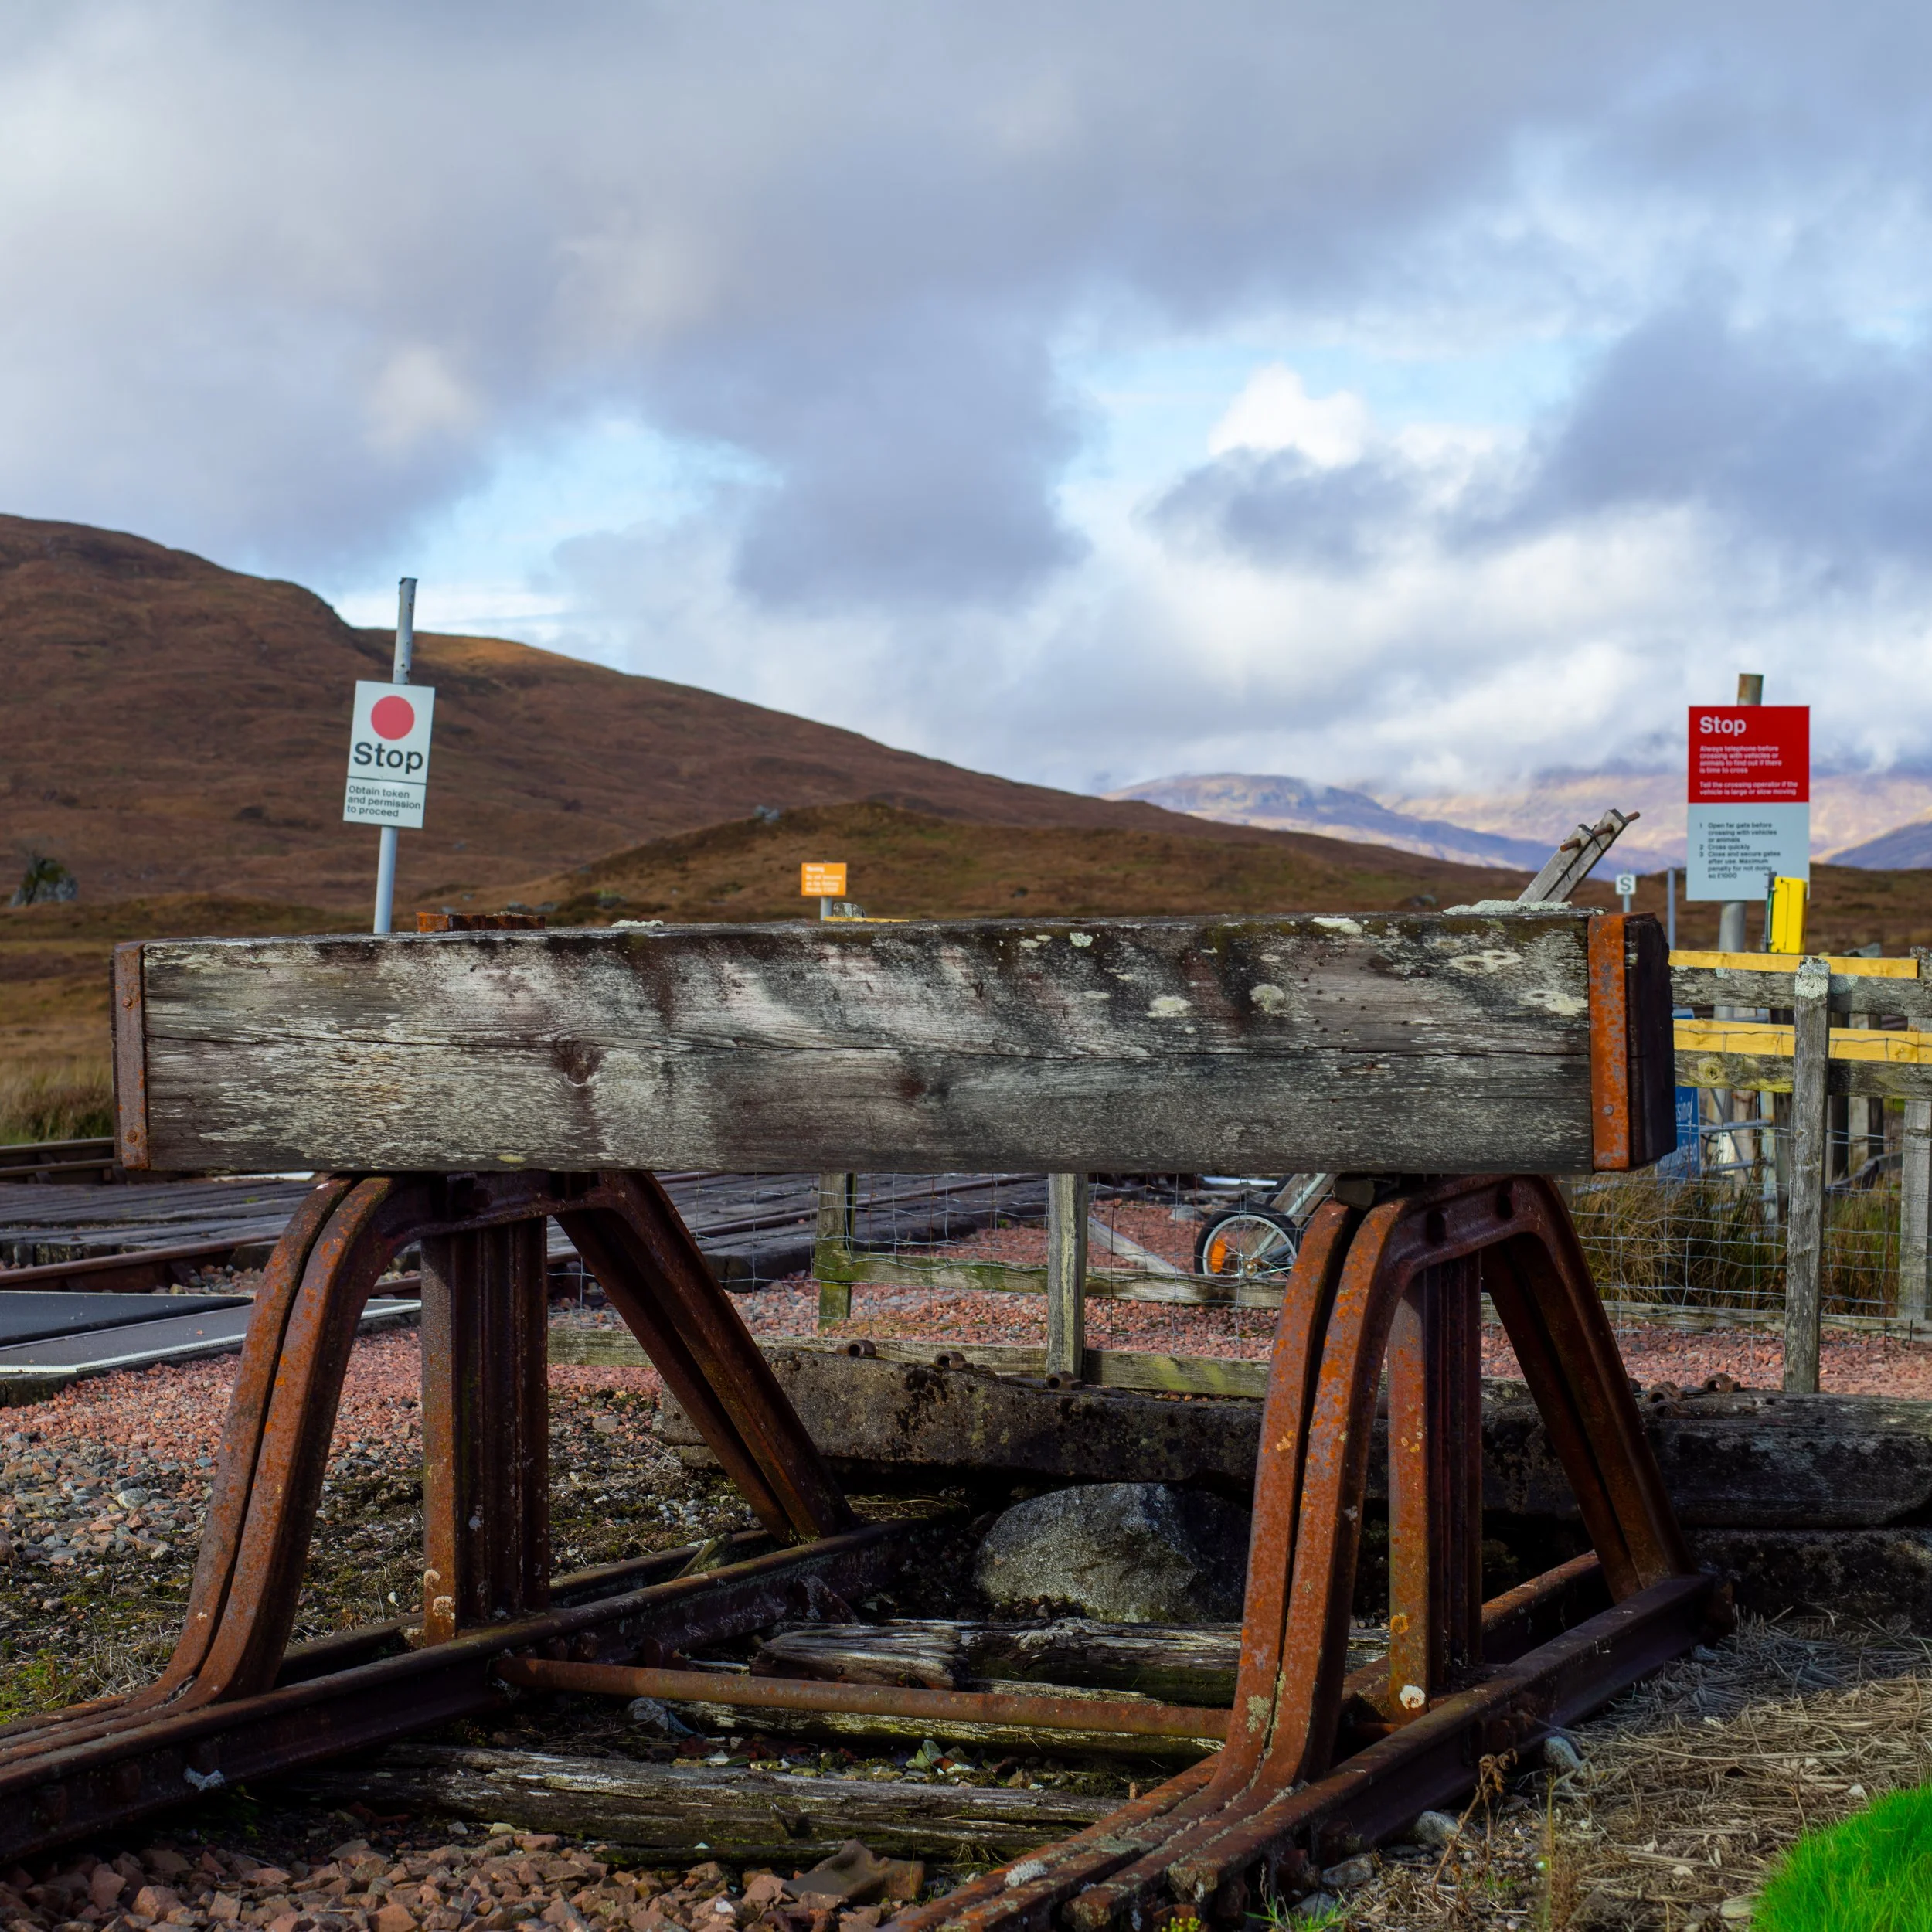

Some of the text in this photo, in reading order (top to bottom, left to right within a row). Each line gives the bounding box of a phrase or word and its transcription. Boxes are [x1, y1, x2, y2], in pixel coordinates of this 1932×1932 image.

[1700, 716, 1746, 737] Stop
[354, 742, 423, 774] Stop
[349, 786, 410, 798] Obtain token
[348, 796, 421, 809] and permission
[359, 807, 399, 817] proceed
[1620, 877, 1631, 891] S
